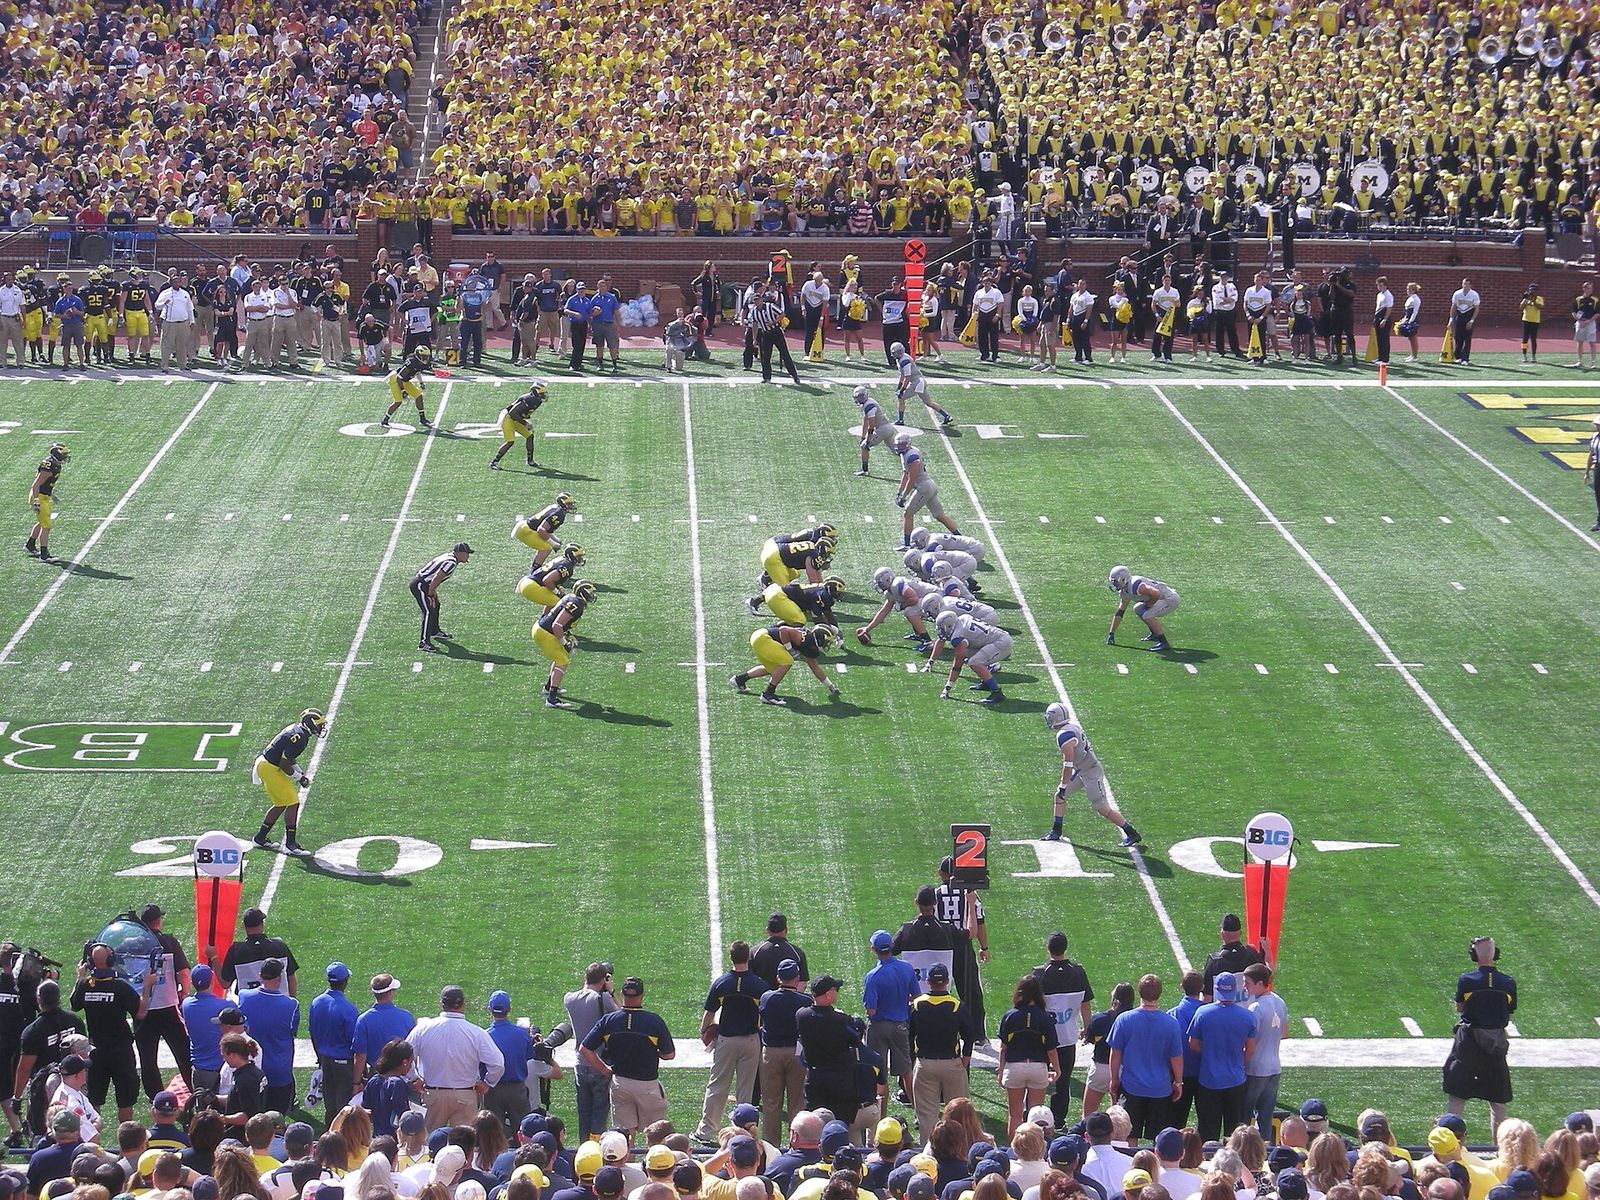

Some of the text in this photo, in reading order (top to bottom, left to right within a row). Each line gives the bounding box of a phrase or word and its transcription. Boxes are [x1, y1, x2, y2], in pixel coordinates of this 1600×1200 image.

[1142, 176, 1153, 184] M
[1193, 176, 1205, 185] M
[1298, 175, 1311, 186] M
[311, 196, 323, 209] 10
[772, 255, 786, 273] 2
[88, 294, 103, 306] 25
[131, 289, 146, 301] 67
[955, 830, 986, 868] 2
[942, 895, 961, 920] H
[84, 991, 115, 1003] ESPN
